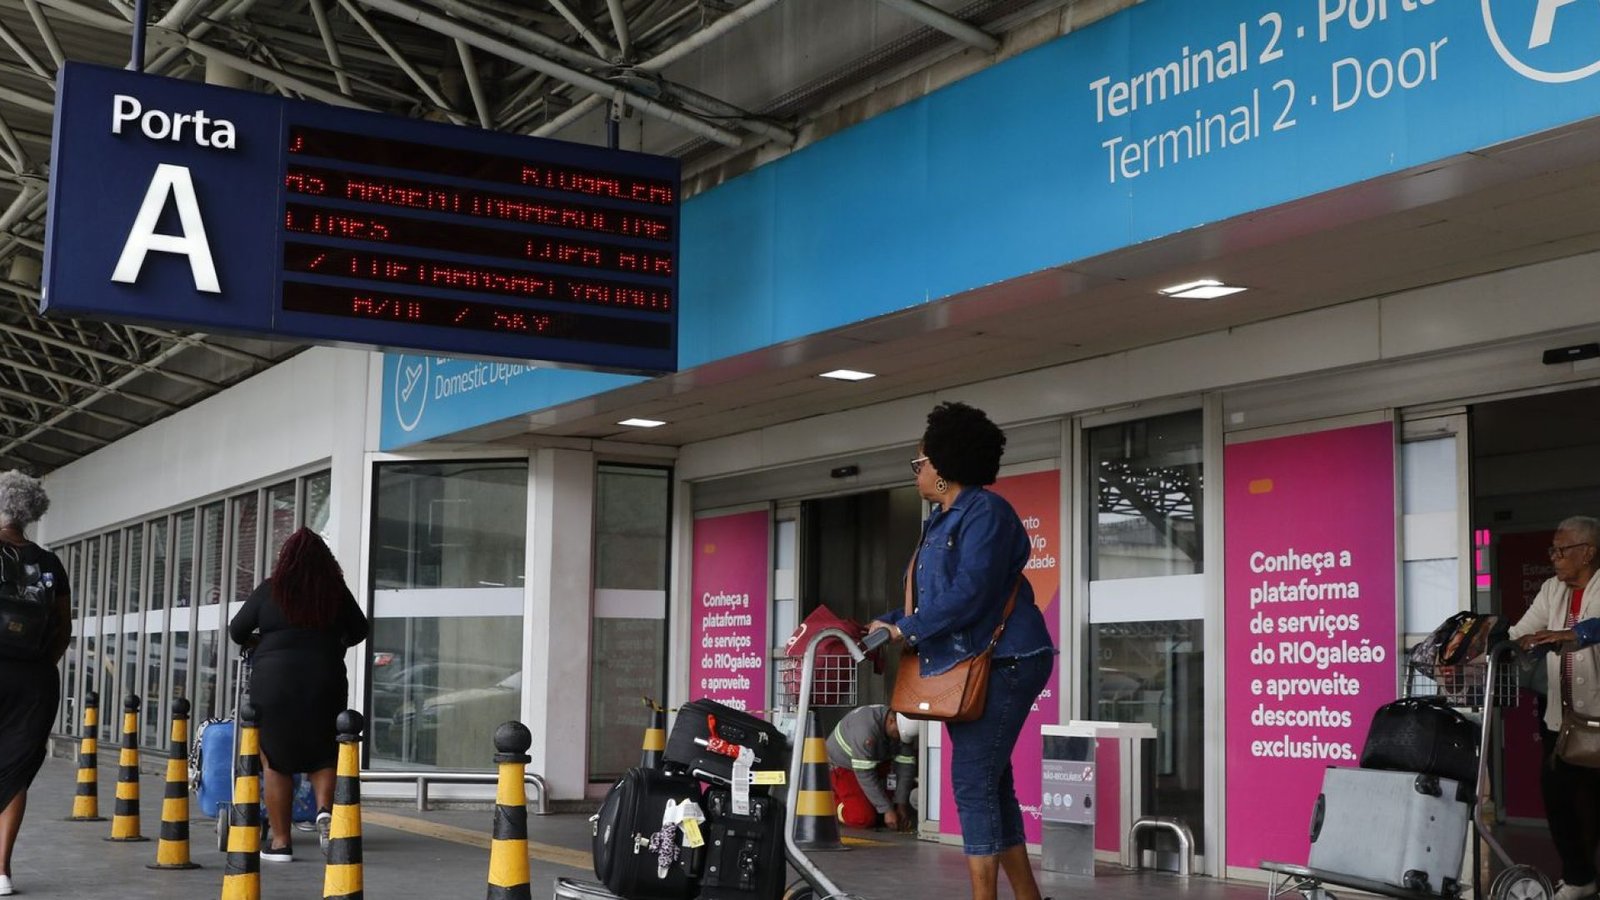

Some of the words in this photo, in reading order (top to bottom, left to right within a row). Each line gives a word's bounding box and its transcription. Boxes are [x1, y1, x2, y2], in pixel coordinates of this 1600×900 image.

[1089, 23, 1247, 123] Terminal
[1258, 11, 1284, 64] 2
[112, 94, 236, 149] Porta
[1102, 88, 1260, 184] Terminal
[1272, 79, 1297, 131] 2
[1332, 37, 1448, 112] Door
[111, 163, 221, 294] A
[435, 362, 488, 400] Domestic
[1250, 548, 1335, 575] Conheça
[1339, 550, 1352, 567] a
[703, 591, 742, 610] Conheça
[743, 592, 749, 608] a
[1250, 578, 1360, 608] plataforma
[702, 612, 752, 631] plataforma
[1250, 611, 1274, 634] de
[1278, 609, 1360, 638] serviços
[702, 633, 713, 648] de
[714, 632, 751, 651] serviços
[1250, 642, 1275, 665] do
[1279, 638, 1386, 670] RIOgaleão
[702, 654, 713, 669] do
[714, 652, 762, 673] RIOgaleão
[701, 679, 707, 690] e
[708, 674, 750, 693] aproveite
[1251, 677, 1262, 695] e
[1266, 672, 1360, 701] aproveite
[1251, 703, 1352, 728] descontos
[1251, 734, 1357, 761] exclusivos.
